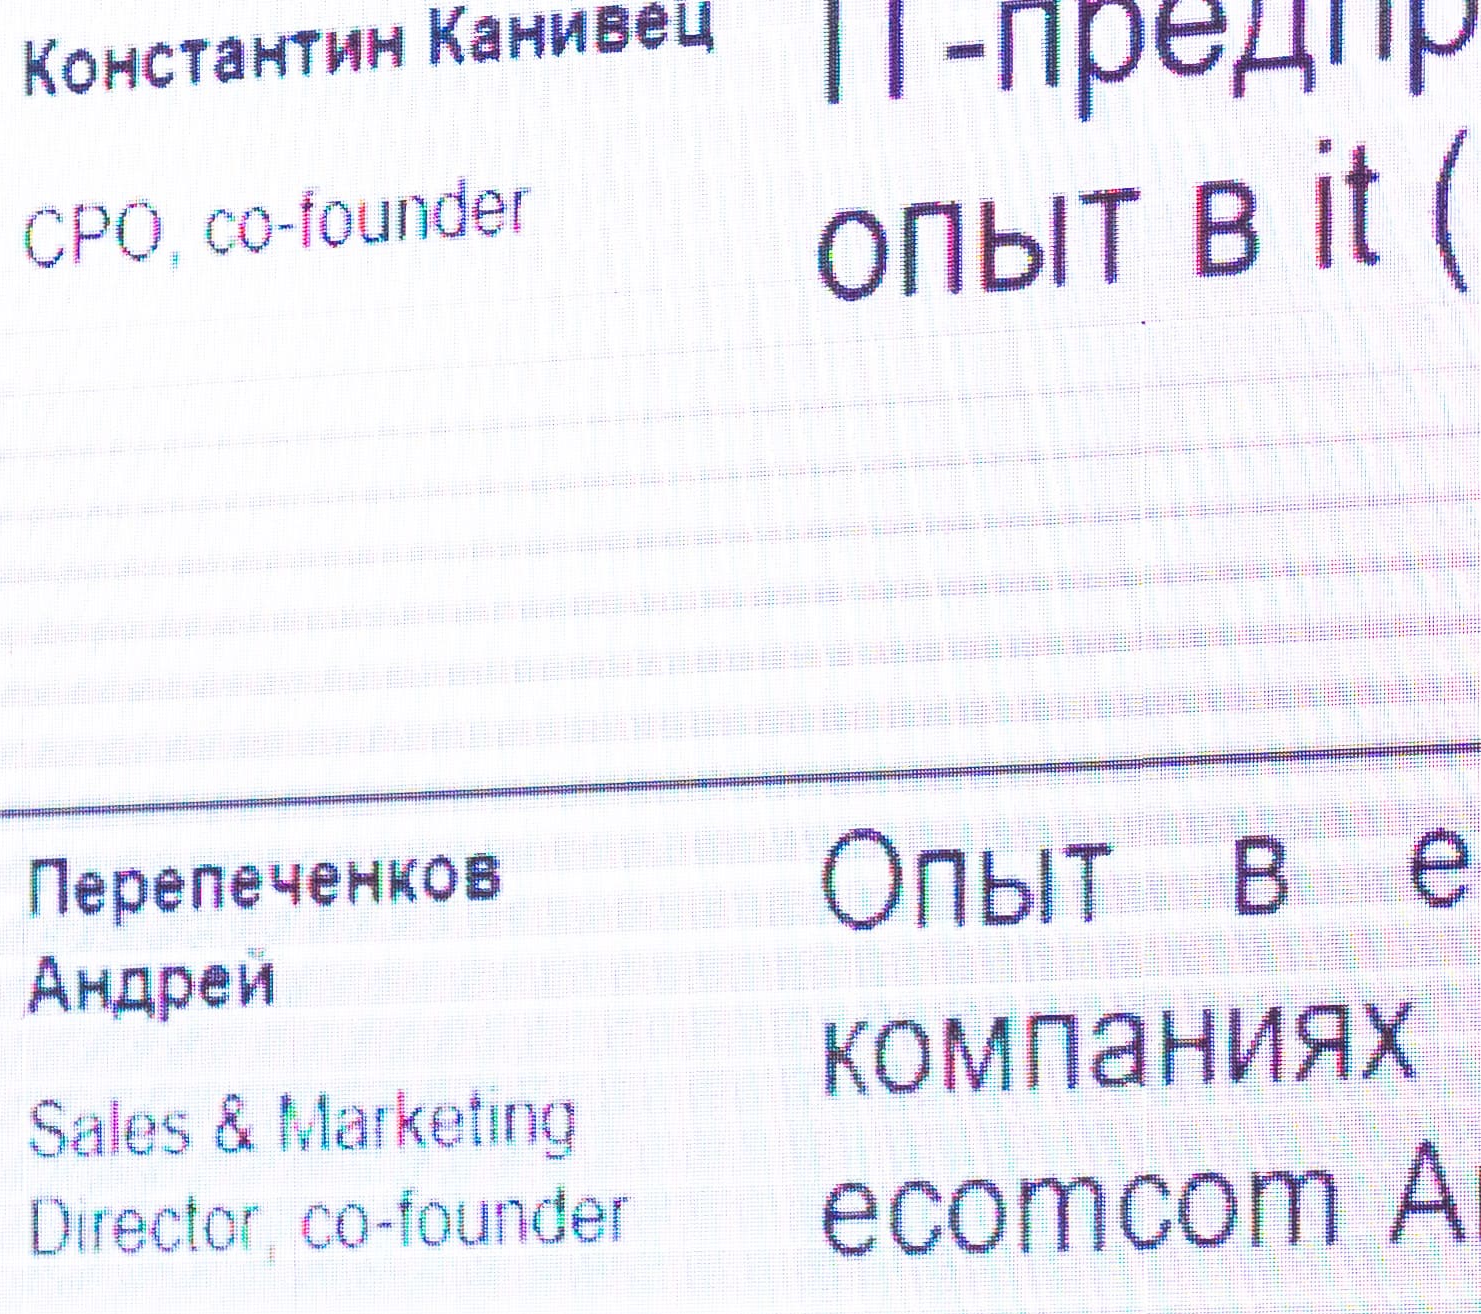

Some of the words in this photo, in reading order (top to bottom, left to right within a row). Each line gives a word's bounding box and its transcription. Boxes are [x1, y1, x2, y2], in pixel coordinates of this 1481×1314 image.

[24, 24, 405, 97] Константин
[428, 1, 716, 66] Канивец
[24, 199, 180, 269] CPO,
[205, 178, 530, 255] co-founder
[817, 186, 1141, 302] опыт
[1196, 179, 1260, 278] в
[1314, 138, 1382, 269] it
[29, 854, 503, 928] Перепеченков
[821, 828, 1113, 930] Опыт
[26, 948, 276, 1022] Андрей
[823, 1001, 1416, 1096] компаниях
[28, 1098, 192, 1159] Sales
[217, 1094, 256, 1151] &
[279, 1088, 577, 1160] Marketing
[302, 1185, 629, 1250] co-founder
[821, 1169, 1339, 1256] ecomcom
